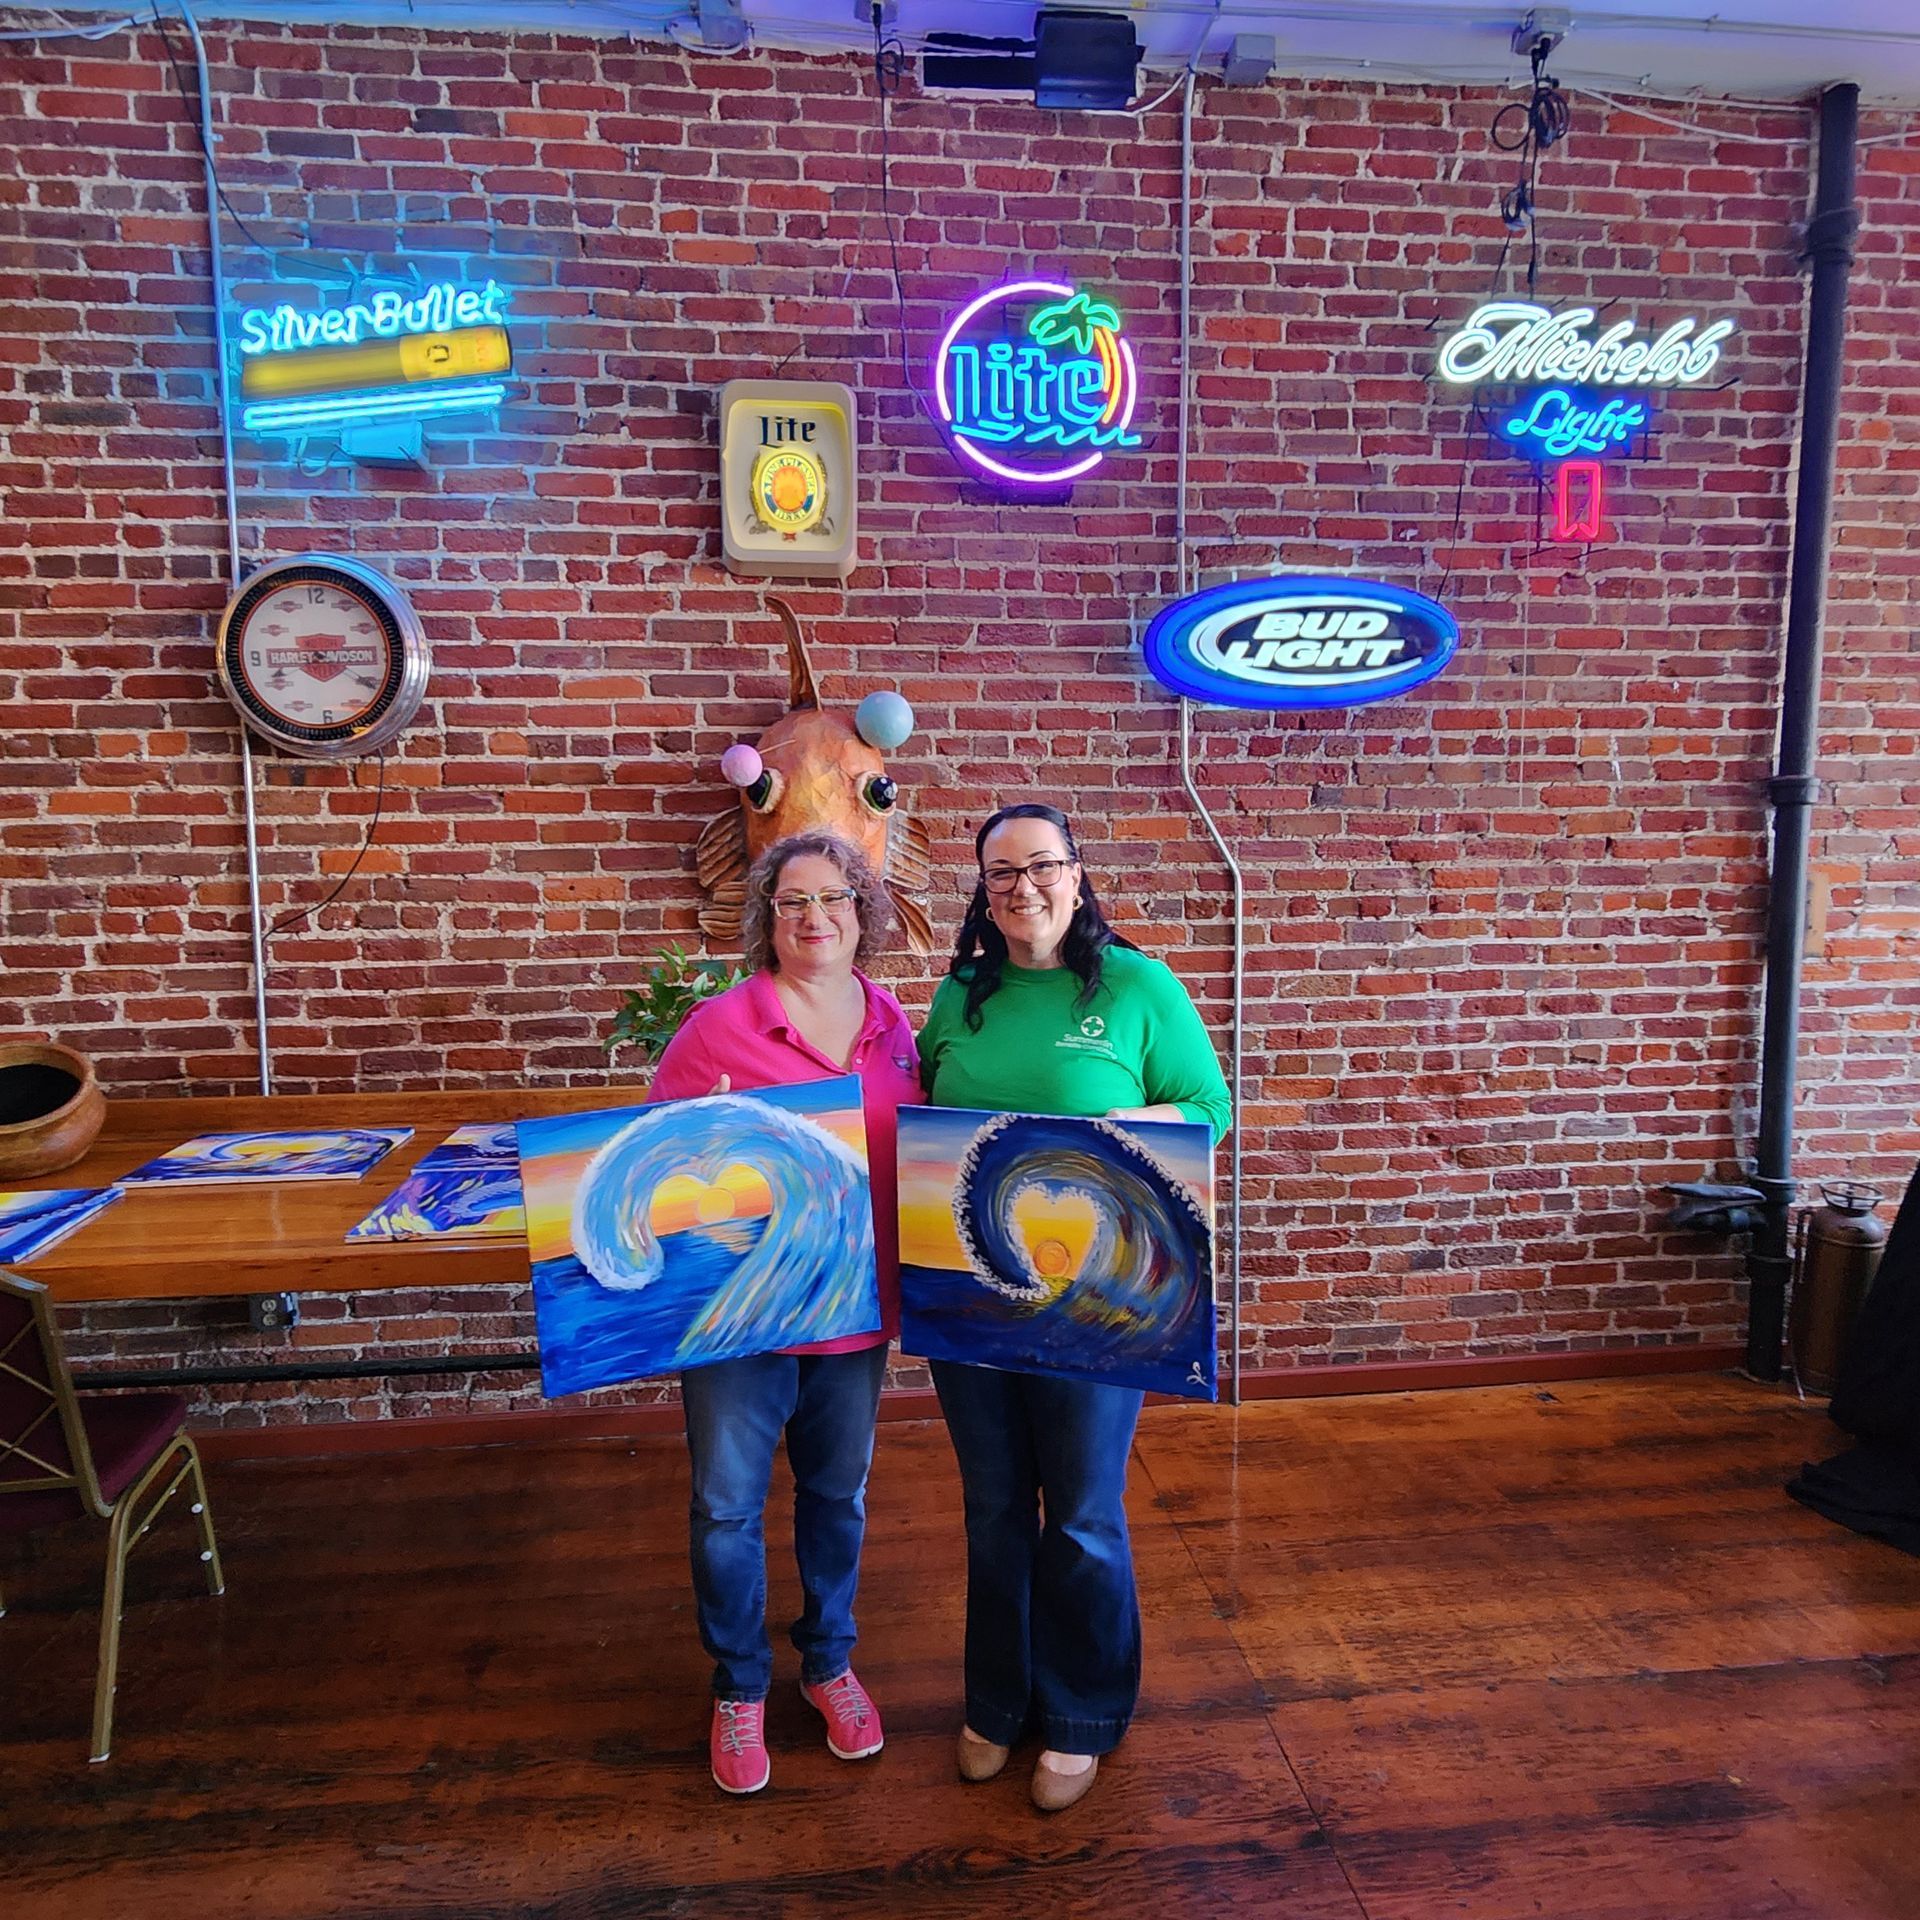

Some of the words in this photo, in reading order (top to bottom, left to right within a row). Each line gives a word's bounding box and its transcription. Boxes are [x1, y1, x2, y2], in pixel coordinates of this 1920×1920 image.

[1440, 302, 1735, 383] Michelob
[949, 341, 1107, 442] Lite
[757, 415, 817, 449] Lite
[1507, 390, 1645, 456] Light
[307, 587, 325, 604] 12
[1252, 611, 1390, 640] BUD
[250, 650, 262, 667] 9
[1223, 639, 1405, 668] LIGHT
[322, 709, 333, 724] 6
